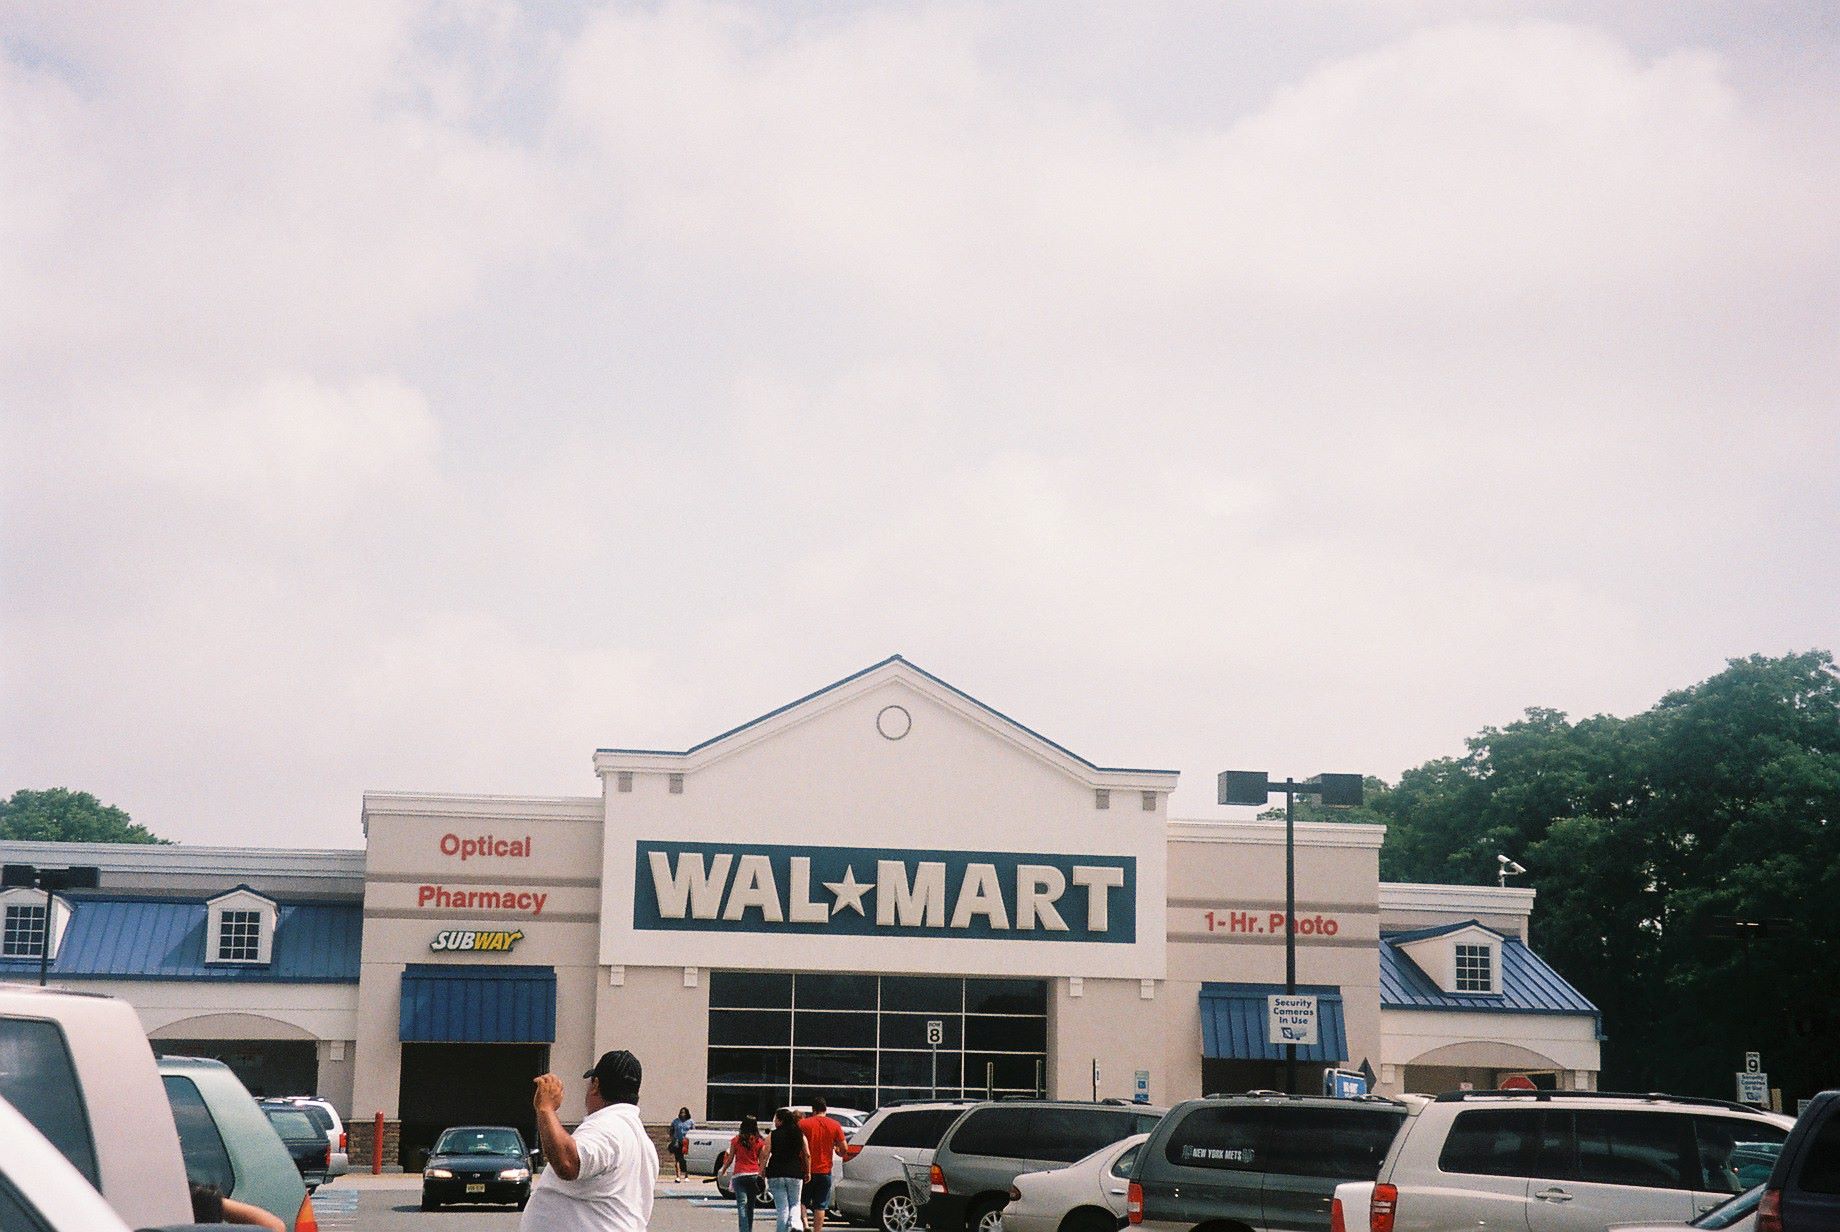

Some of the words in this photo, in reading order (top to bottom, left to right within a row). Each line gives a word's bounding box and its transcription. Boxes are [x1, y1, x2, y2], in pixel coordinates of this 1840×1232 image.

[440, 833, 531, 861] Optical
[417, 885, 548, 916] Pharmacy
[1204, 911, 1264, 934] 1-Hr.
[431, 930, 524, 951] SUBWAY
[1275, 998, 1312, 1009] Security
[1273, 1007, 1314, 1016] Cameras
[1291, 1016, 1308, 1024] Use
[930, 1028, 940, 1042] 8
[1748, 1059, 1758, 1072] 9
[1192, 1148, 1207, 1158] NEW
[1208, 1149, 1224, 1159] YORK
[1224, 1150, 1242, 1161] METS
